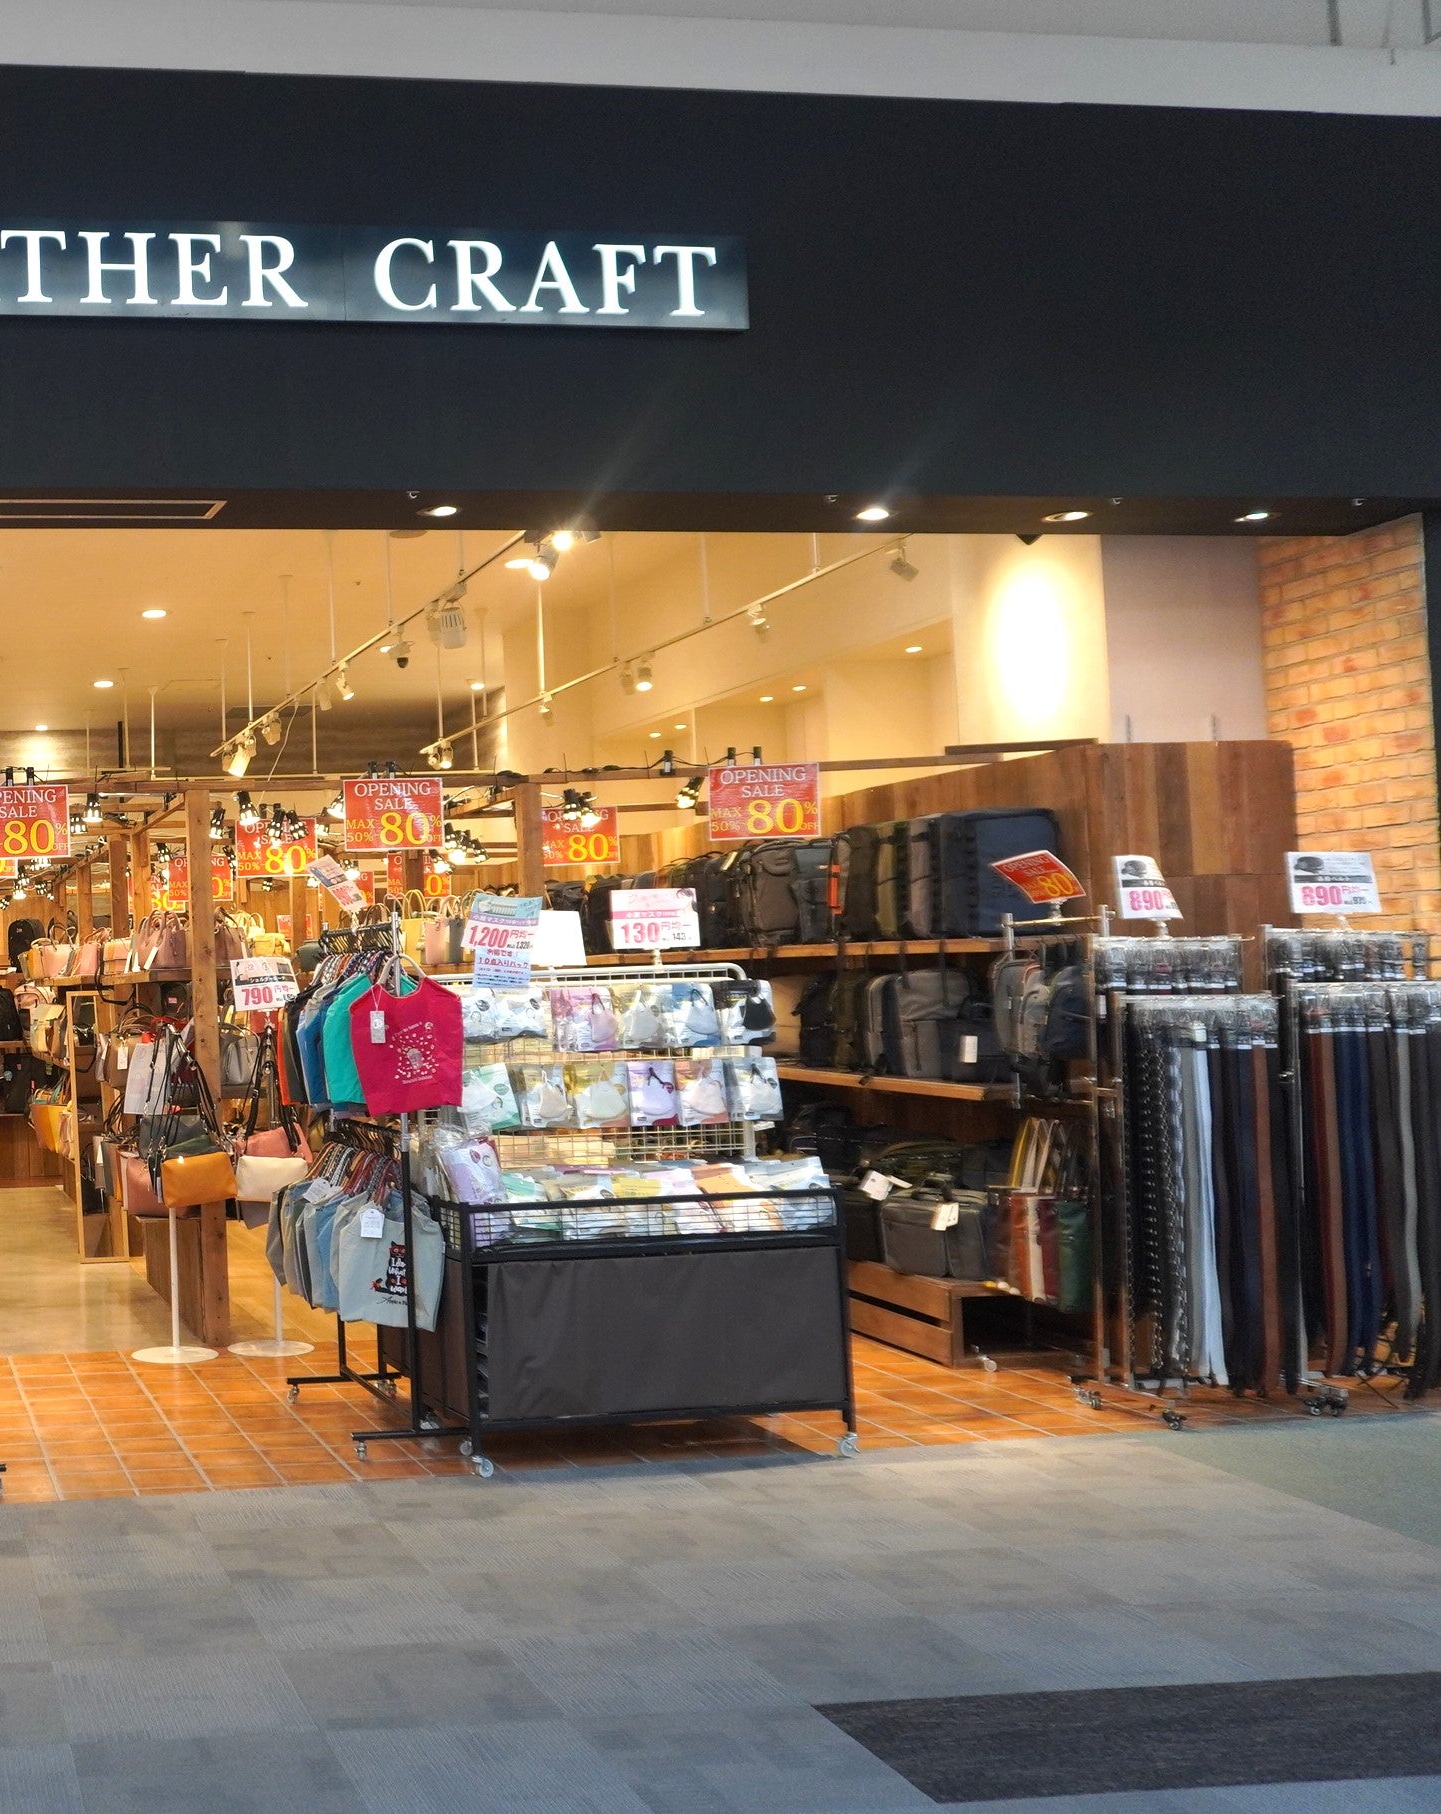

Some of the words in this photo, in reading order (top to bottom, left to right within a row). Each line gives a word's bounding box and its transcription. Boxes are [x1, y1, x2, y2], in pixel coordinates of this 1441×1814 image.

[372, 237, 719, 318] CRAFT
[720, 767, 807, 785] OPENING
[354, 782, 431, 797] OPENING
[741, 784, 786, 798] SALE
[374, 798, 415, 810] SALE
[710, 806, 743, 818] MAX
[346, 819, 375, 829] MAX
[261, 835, 293, 844] SE
[238, 852, 262, 860] MAX
[1129, 890, 1164, 911] 890
[1302, 886, 1343, 906] 890
[469, 925, 510, 948] 1,200
[621, 922, 660, 943] 130
[241, 986, 273, 1006] 790
